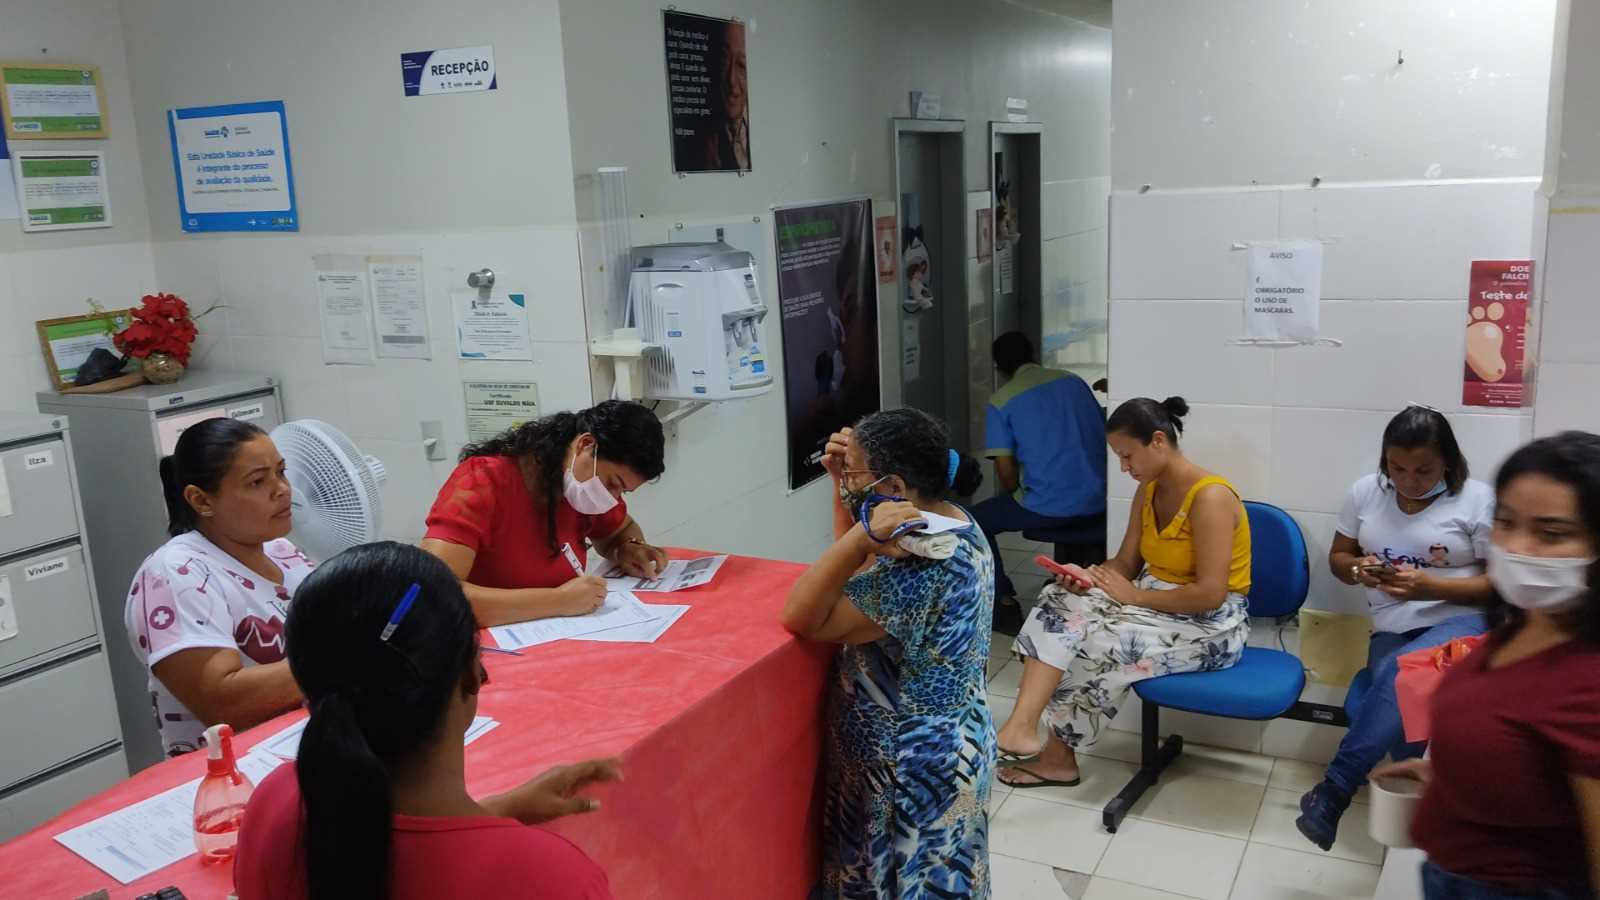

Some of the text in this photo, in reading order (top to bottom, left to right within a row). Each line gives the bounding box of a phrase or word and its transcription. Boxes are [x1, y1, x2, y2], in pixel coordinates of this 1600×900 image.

[431, 58, 489, 76] RECEPÇÃO
[1269, 252, 1294, 260] AVISO
[1480, 290, 1513, 301] Teste
[28, 561, 64, 577] Viviane
